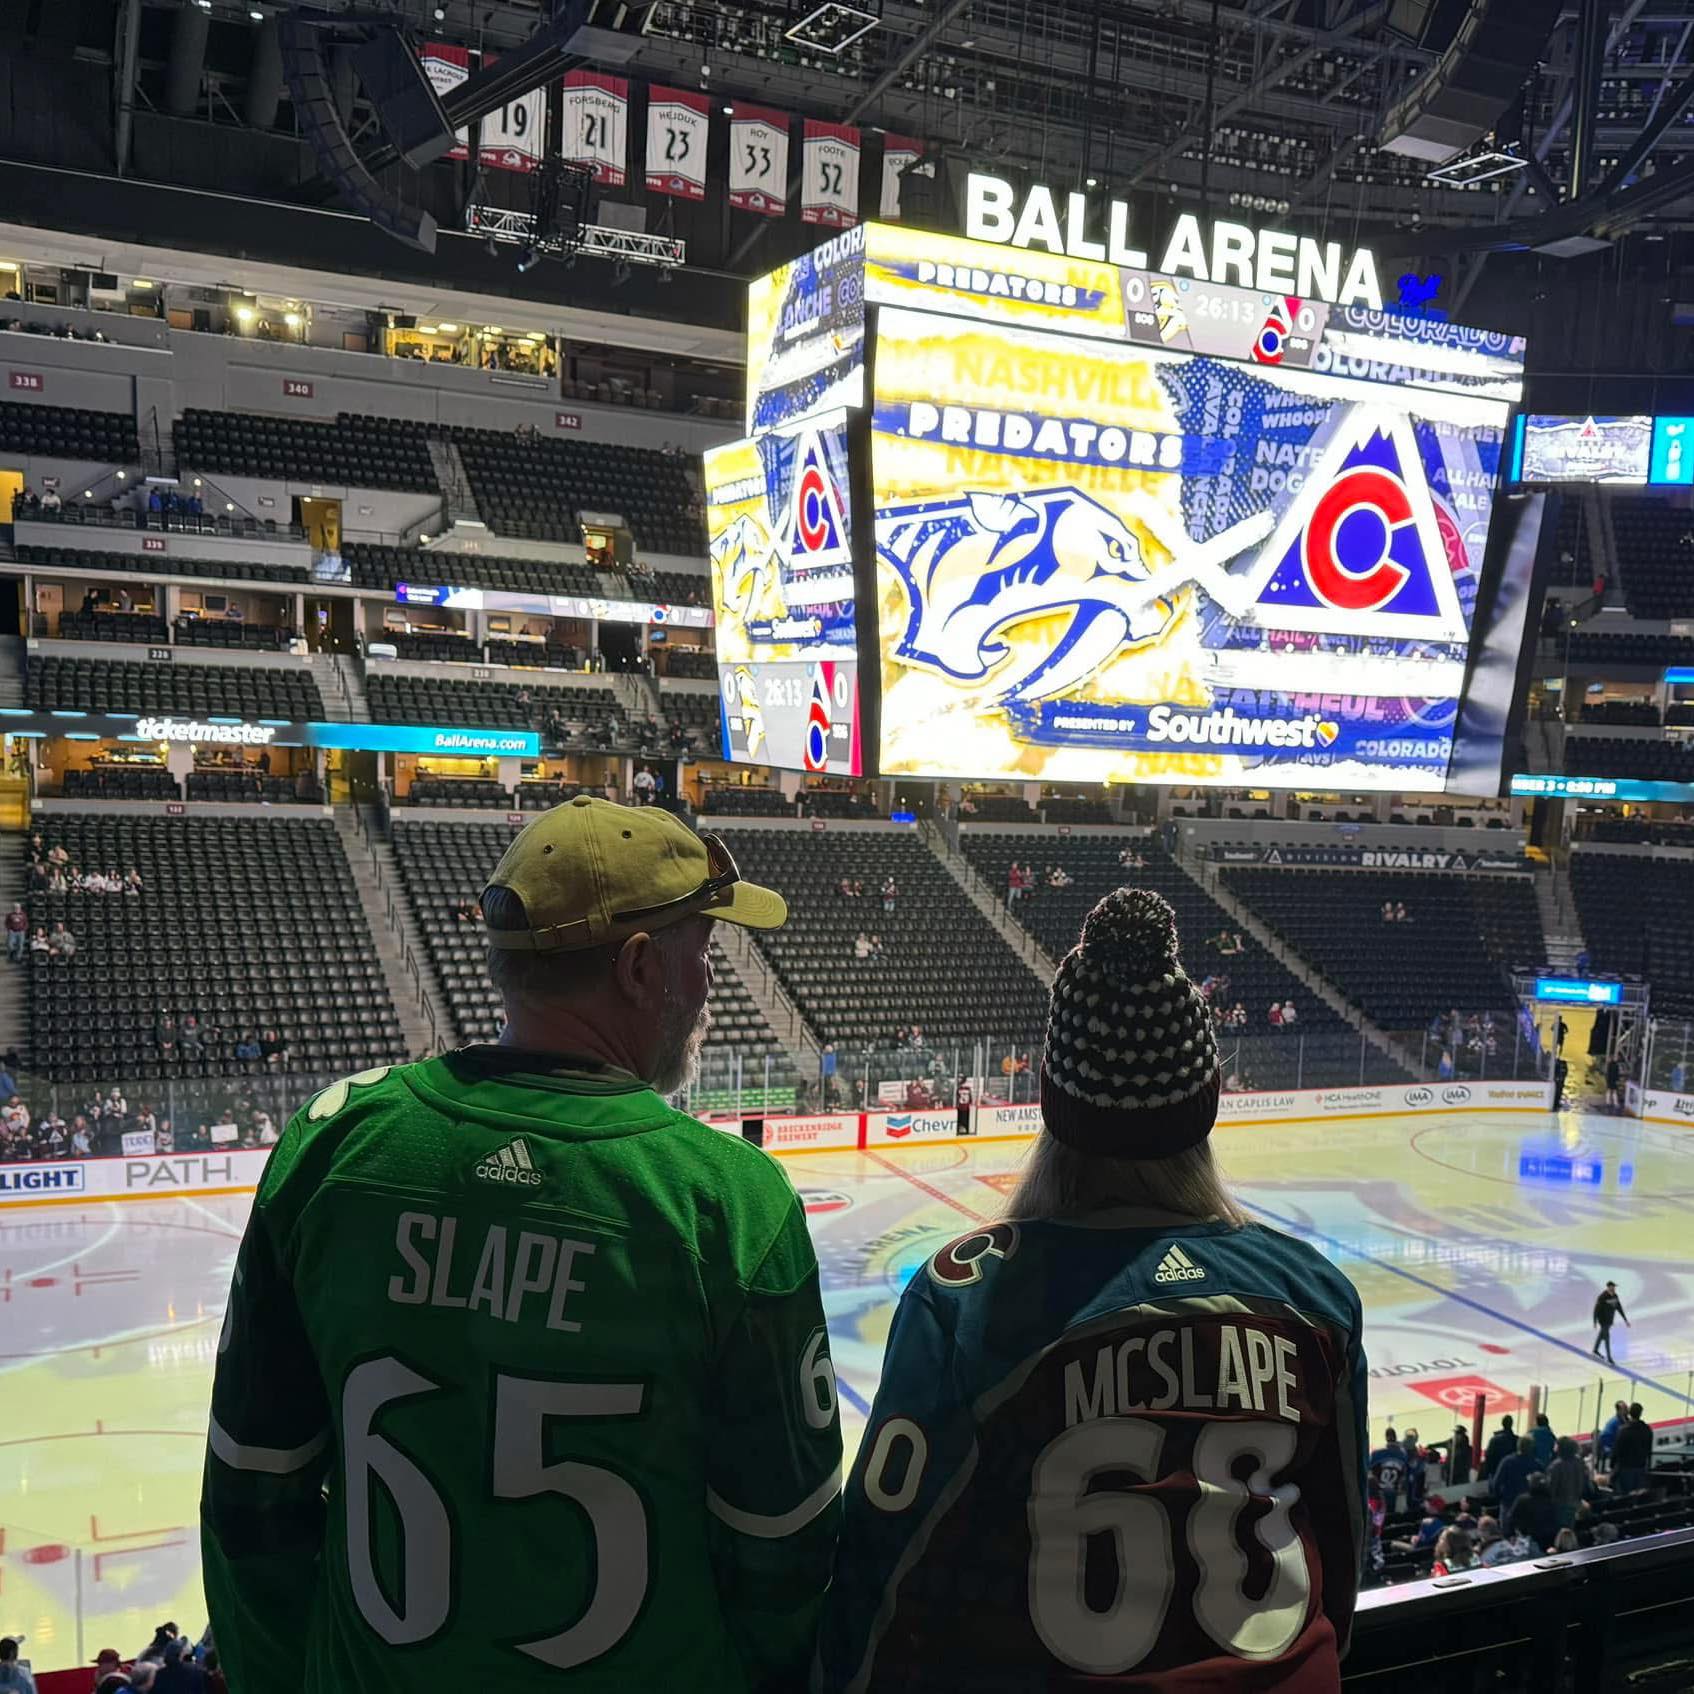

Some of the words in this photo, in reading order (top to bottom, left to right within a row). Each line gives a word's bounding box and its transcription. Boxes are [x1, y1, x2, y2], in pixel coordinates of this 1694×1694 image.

[501, 103, 528, 137] 19
[585, 113, 606, 149] 21
[658, 111, 698, 127] HEJDUK
[665, 127, 690, 162] 23
[749, 128, 769, 140] ROY
[744, 144, 771, 178] 33
[818, 145, 846, 157] FOOTE
[820, 161, 843, 195] 52
[966, 173, 1147, 269] BALL
[1159, 215, 1383, 310] ARENA
[917, 261, 1077, 306] PREDATORS
[1126, 277, 1145, 303] 0
[1195, 294, 1255, 324] 26:13
[1298, 307, 1316, 332] 0
[15, 376, 37, 388] 338
[287, 383, 309, 395] 340
[559, 415, 578, 427] 342
[908, 401, 1183, 468] PREDATORS
[1255, 439, 1326, 469] NATE
[723, 671, 736, 704] 0
[833, 672, 848, 708] 0
[1212, 686, 1385, 720] FAITHFUL
[136, 718, 275, 744] ticketmaster
[1119, 718, 1136, 732] BY
[1146, 705, 1316, 749] Southwest
[434, 733, 527, 750] BallArena.com
[1286, 853, 1358, 862] DIVISION
[1362, 852, 1451, 869] RIVALRY
[1236, 1098, 1271, 1109] CAPLIS
[1273, 1096, 1296, 1107] LAW
[1324, 1094, 1342, 1103] HCA
[777, 1122, 844, 1133] BRECKENRIDGE
[912, 1118, 957, 1133] Chevr
[996, 1108, 1017, 1122] NEW
[0, 1170, 79, 1191] LIGHT
[125, 1156, 232, 1188] PATH
[475, 1164, 543, 1185] adidas
[387, 1210, 597, 1333] SLAPE
[1154, 1265, 1206, 1284] adidas
[1064, 1324, 1301, 1429] MCSLAPE
[1368, 1357, 1478, 1378] TOYOTA
[799, 1331, 837, 1431] 6
[863, 1417, 928, 1513] 0
[341, 1355, 650, 1670] 65
